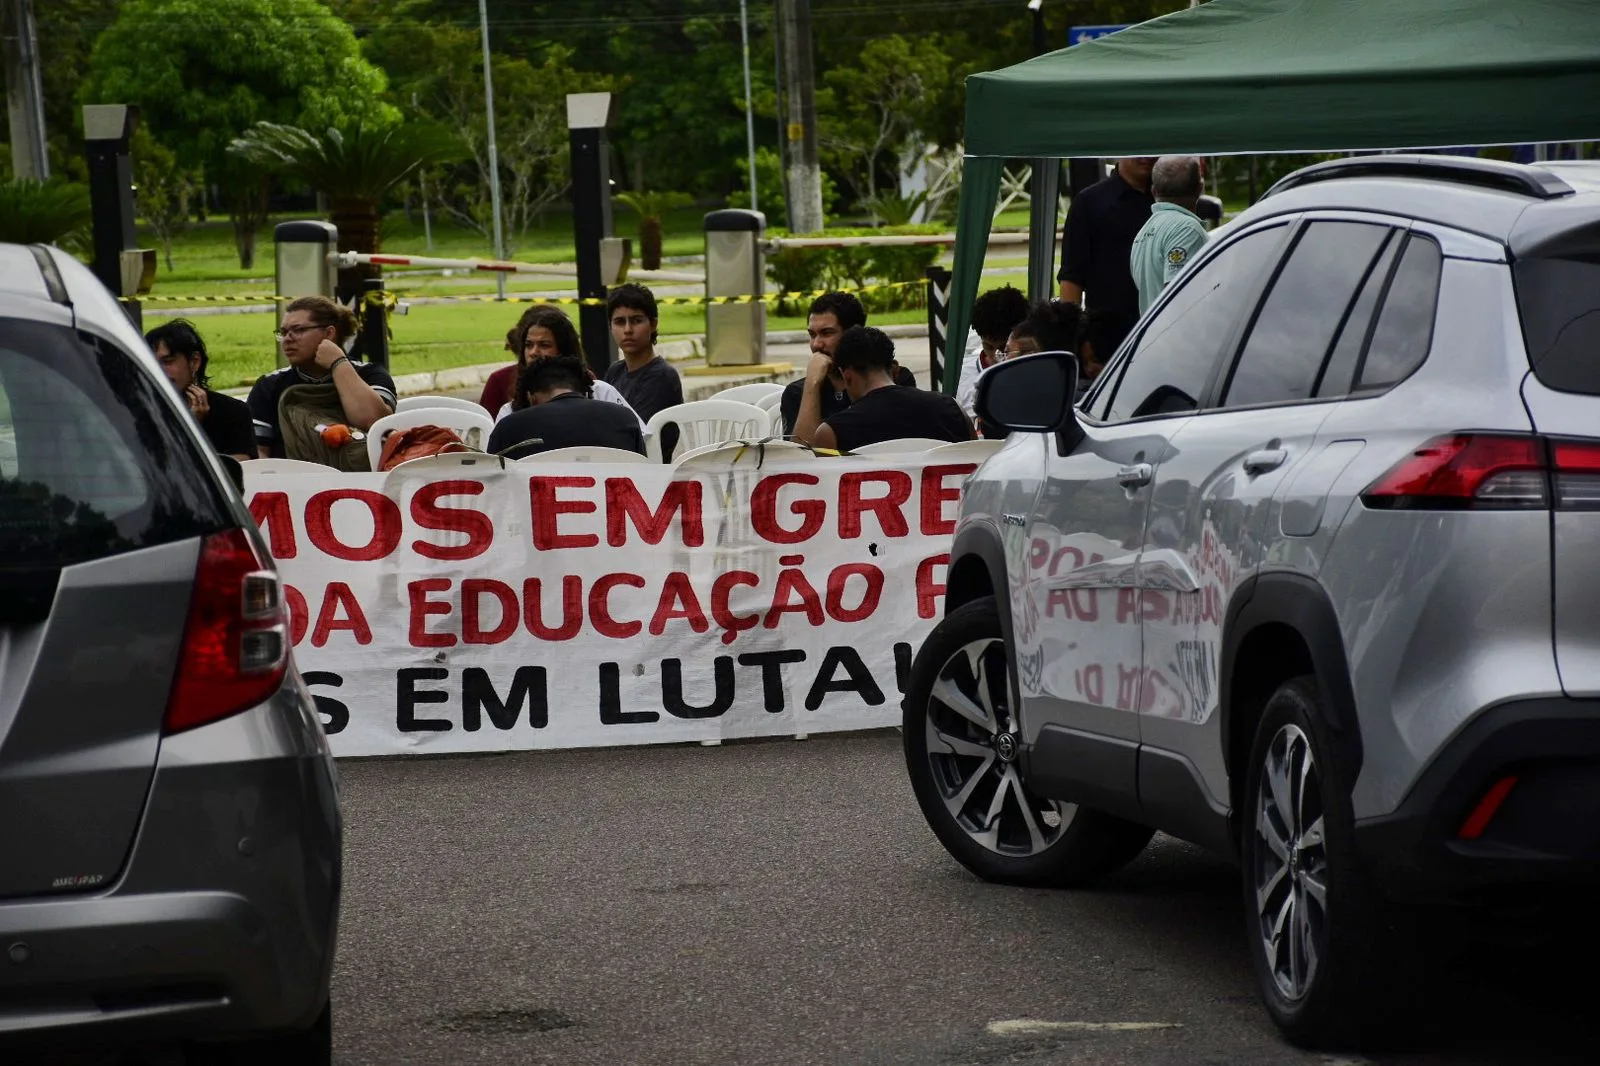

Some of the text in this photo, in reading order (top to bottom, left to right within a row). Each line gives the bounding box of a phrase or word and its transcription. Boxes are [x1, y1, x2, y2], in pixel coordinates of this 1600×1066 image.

[530, 475, 704, 551] EM
[751, 464, 977, 544] GRE
[408, 554, 884, 647] EDUCAÇÃO
[397, 666, 548, 732] EM
